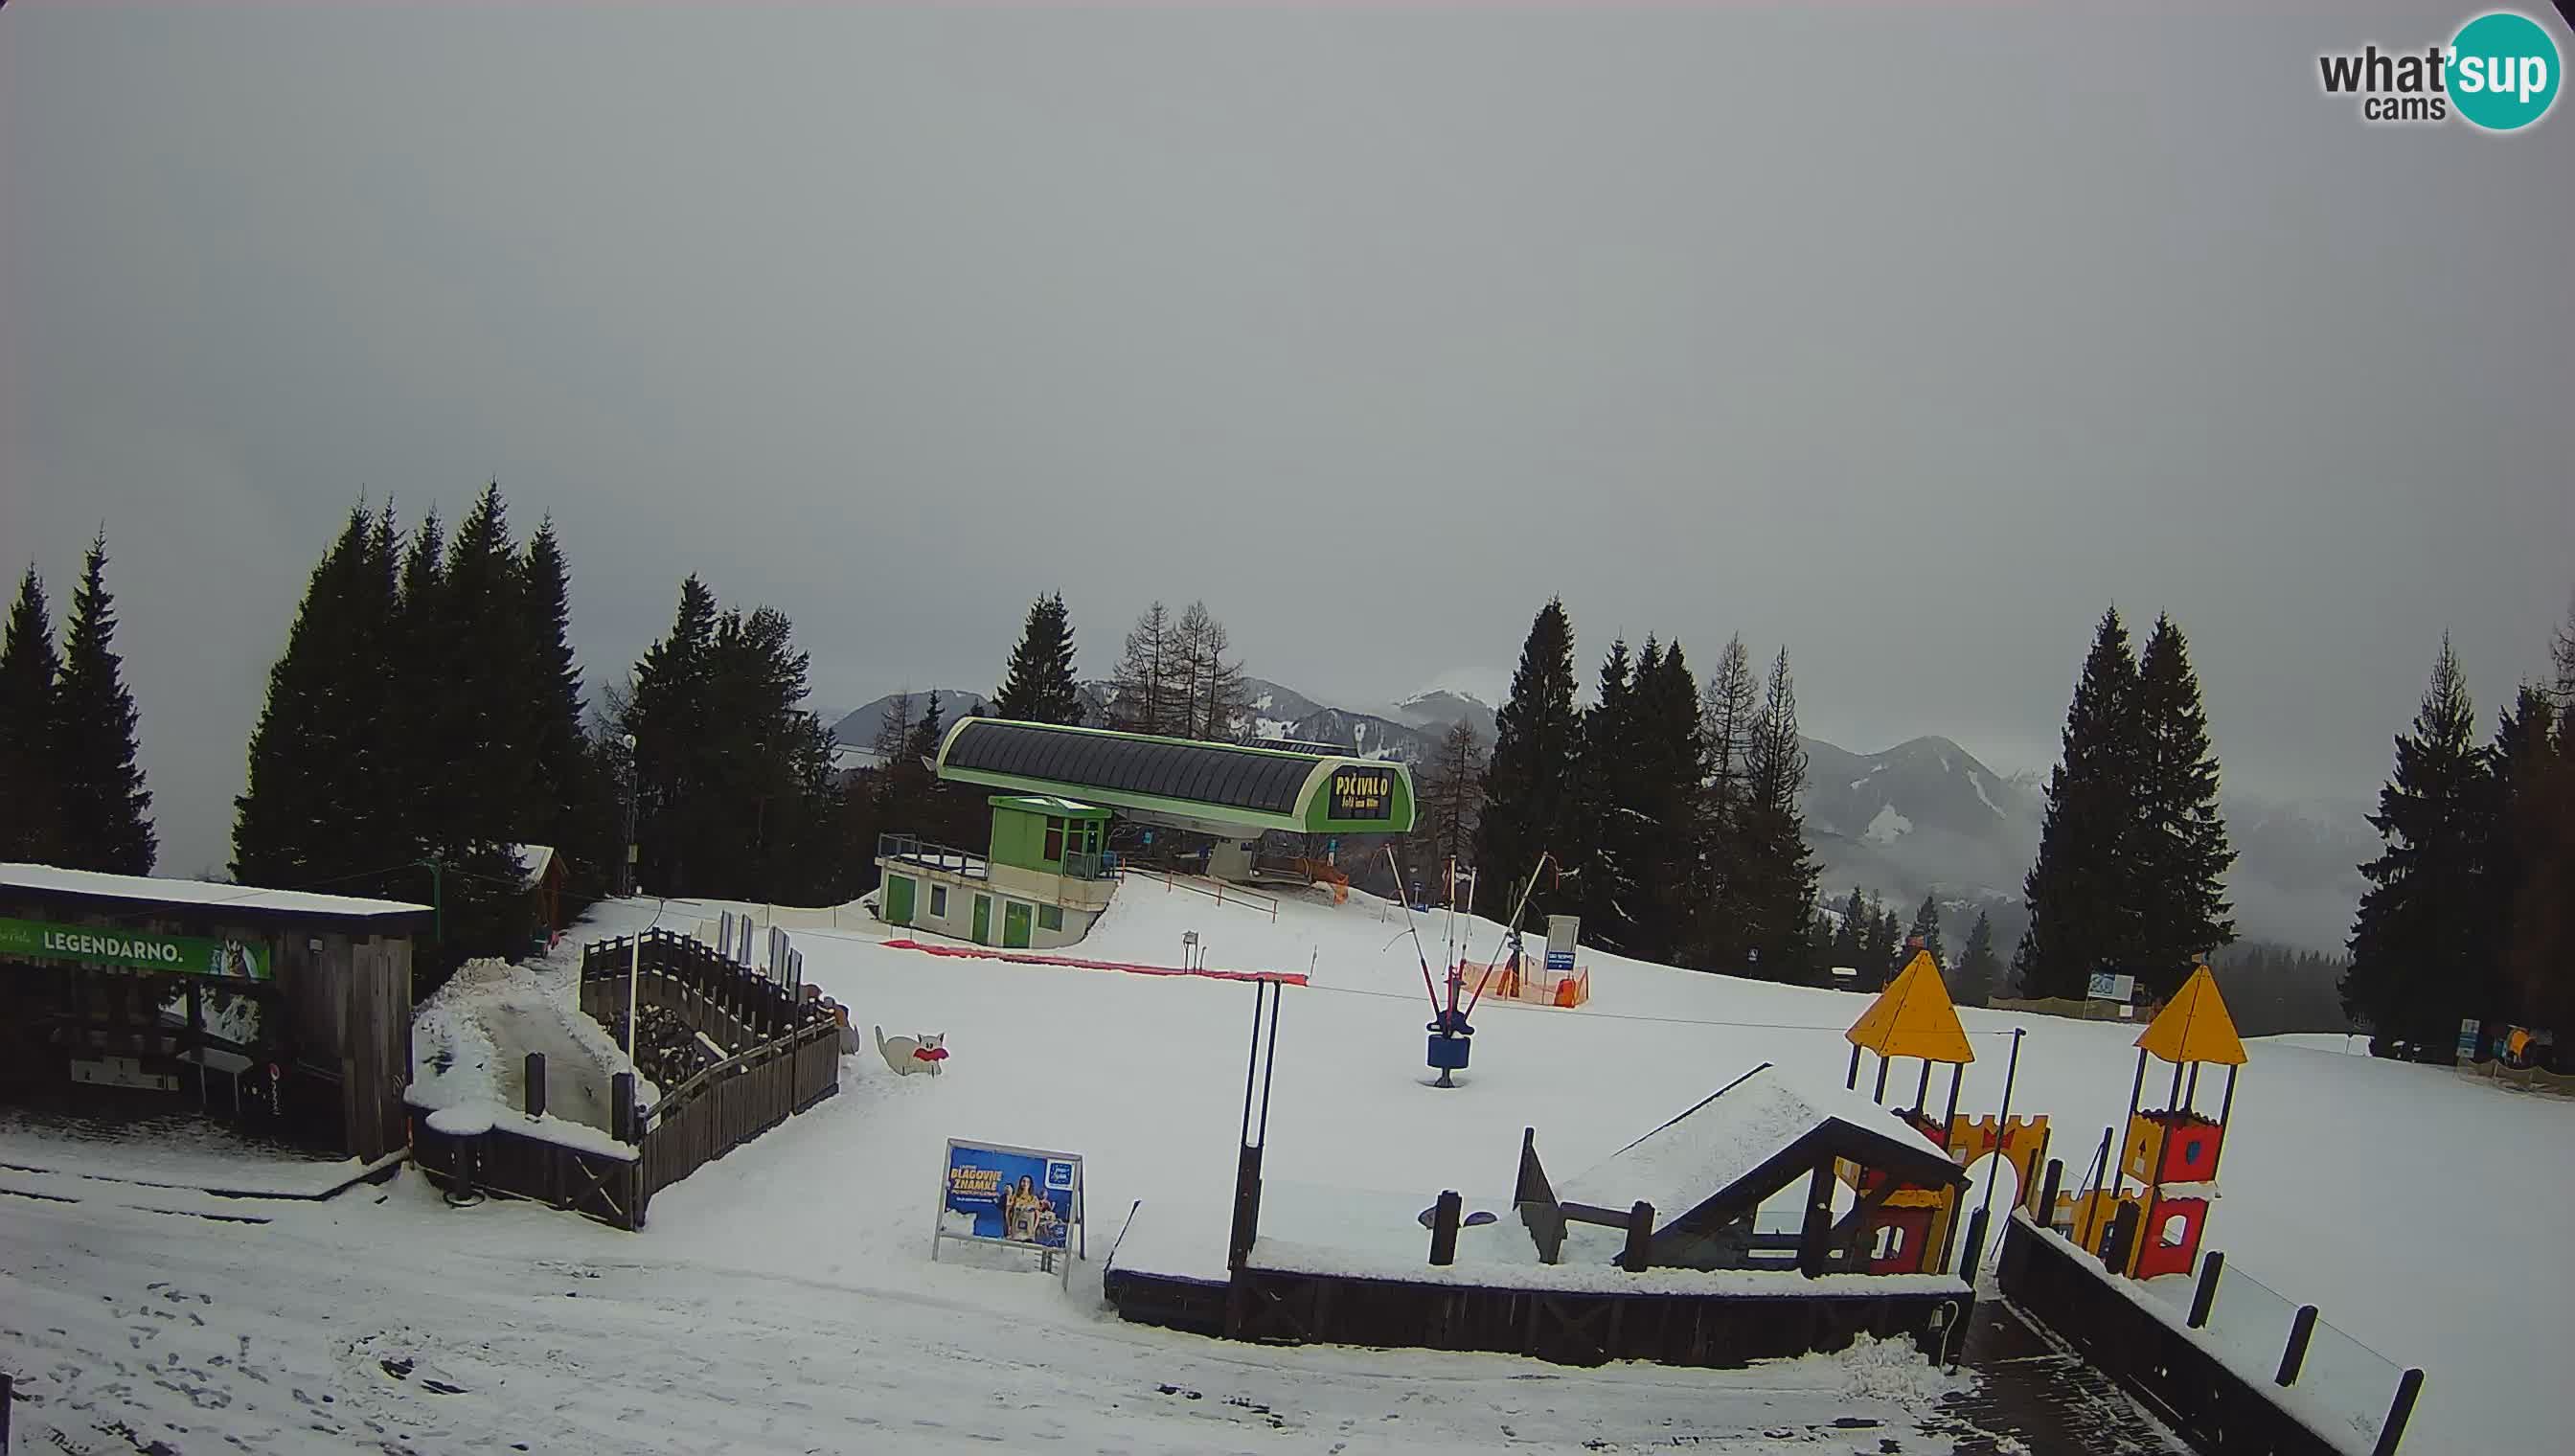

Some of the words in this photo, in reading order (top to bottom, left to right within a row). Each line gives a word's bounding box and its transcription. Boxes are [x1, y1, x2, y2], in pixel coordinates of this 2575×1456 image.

[44, 931, 184, 964] LEGENDARNO.
[950, 1168, 1004, 1181] BLAGOVNE
[953, 1178, 998, 1191] ZNAMKE
